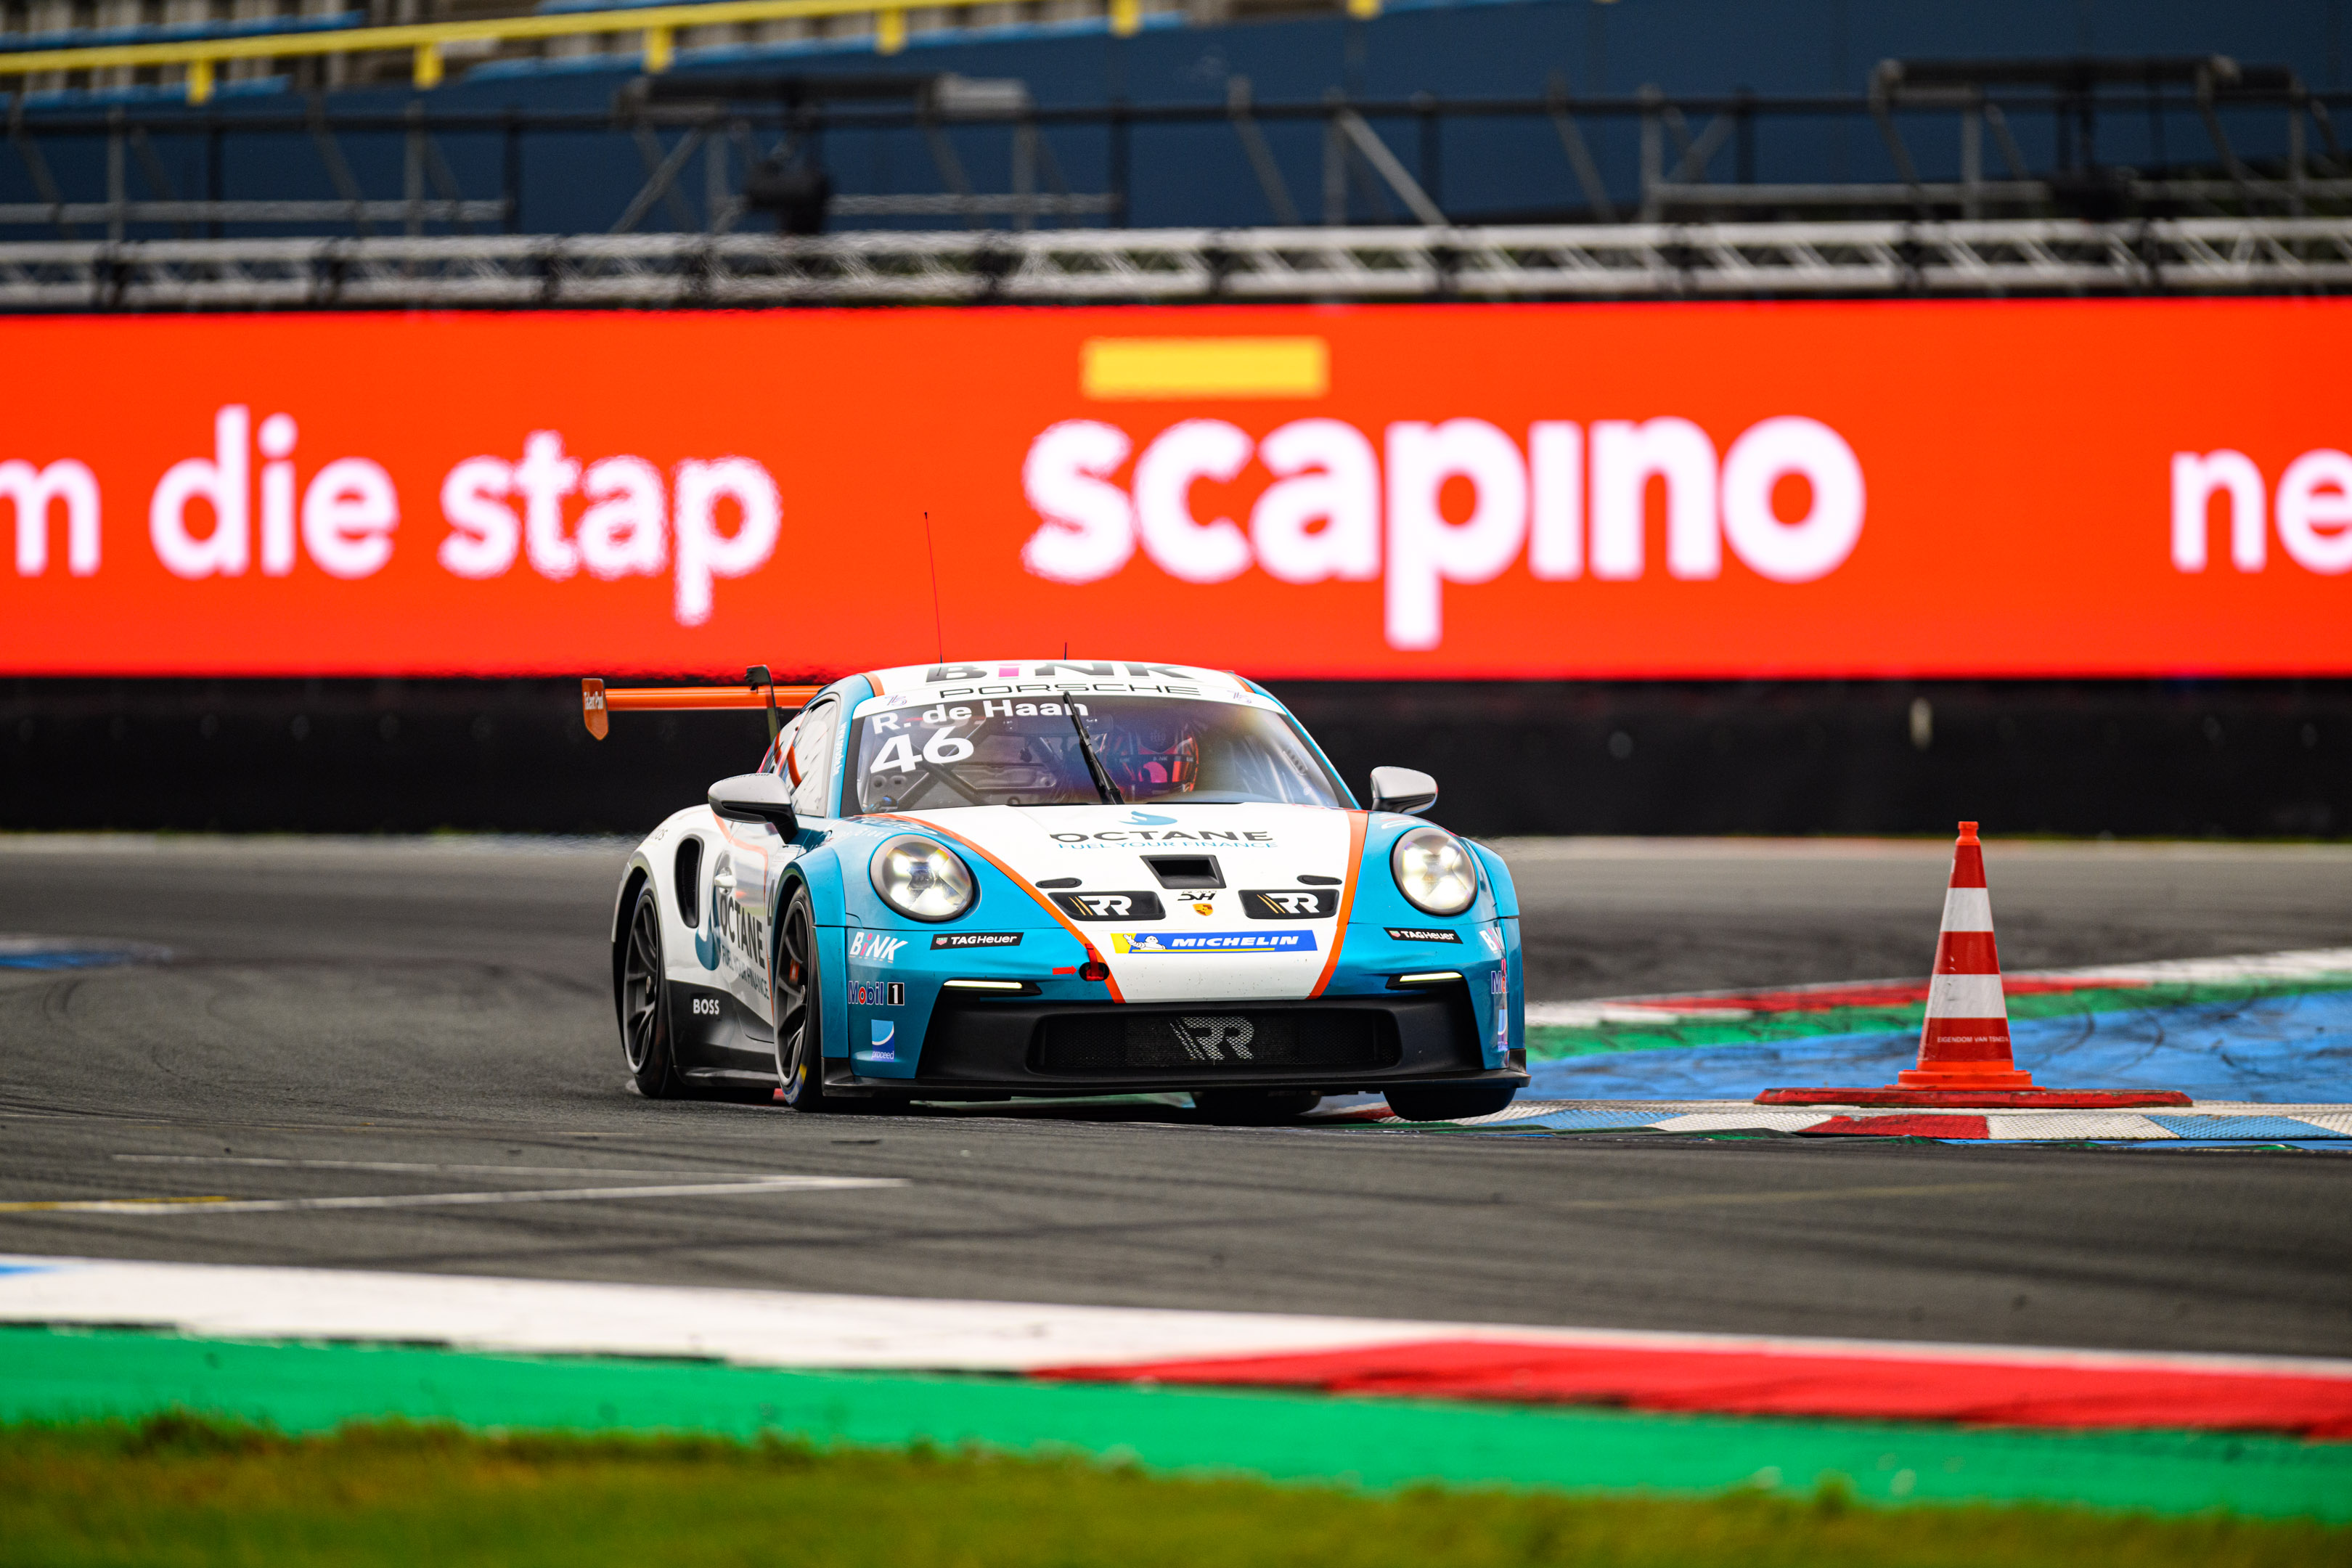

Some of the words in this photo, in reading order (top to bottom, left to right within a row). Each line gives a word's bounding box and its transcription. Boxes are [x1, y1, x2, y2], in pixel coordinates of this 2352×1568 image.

[150, 404, 398, 579] die
[438, 430, 782, 626] stap
[2171, 447, 2352, 576] ne
[1021, 416, 1866, 650] scapino
[939, 683, 1201, 698] PORSCHE
[872, 712, 912, 735] R.
[922, 703, 973, 724] de
[982, 699, 1089, 718] Haan
[870, 726, 974, 775] 46
[1049, 830, 1273, 843] OCTANE
[719, 893, 766, 970] OCTANE
[1172, 936, 1299, 947] MICHELIN
[693, 999, 719, 1015] BOSS
[848, 980, 884, 1005] Mobil
[872, 1050, 894, 1060] proceed
